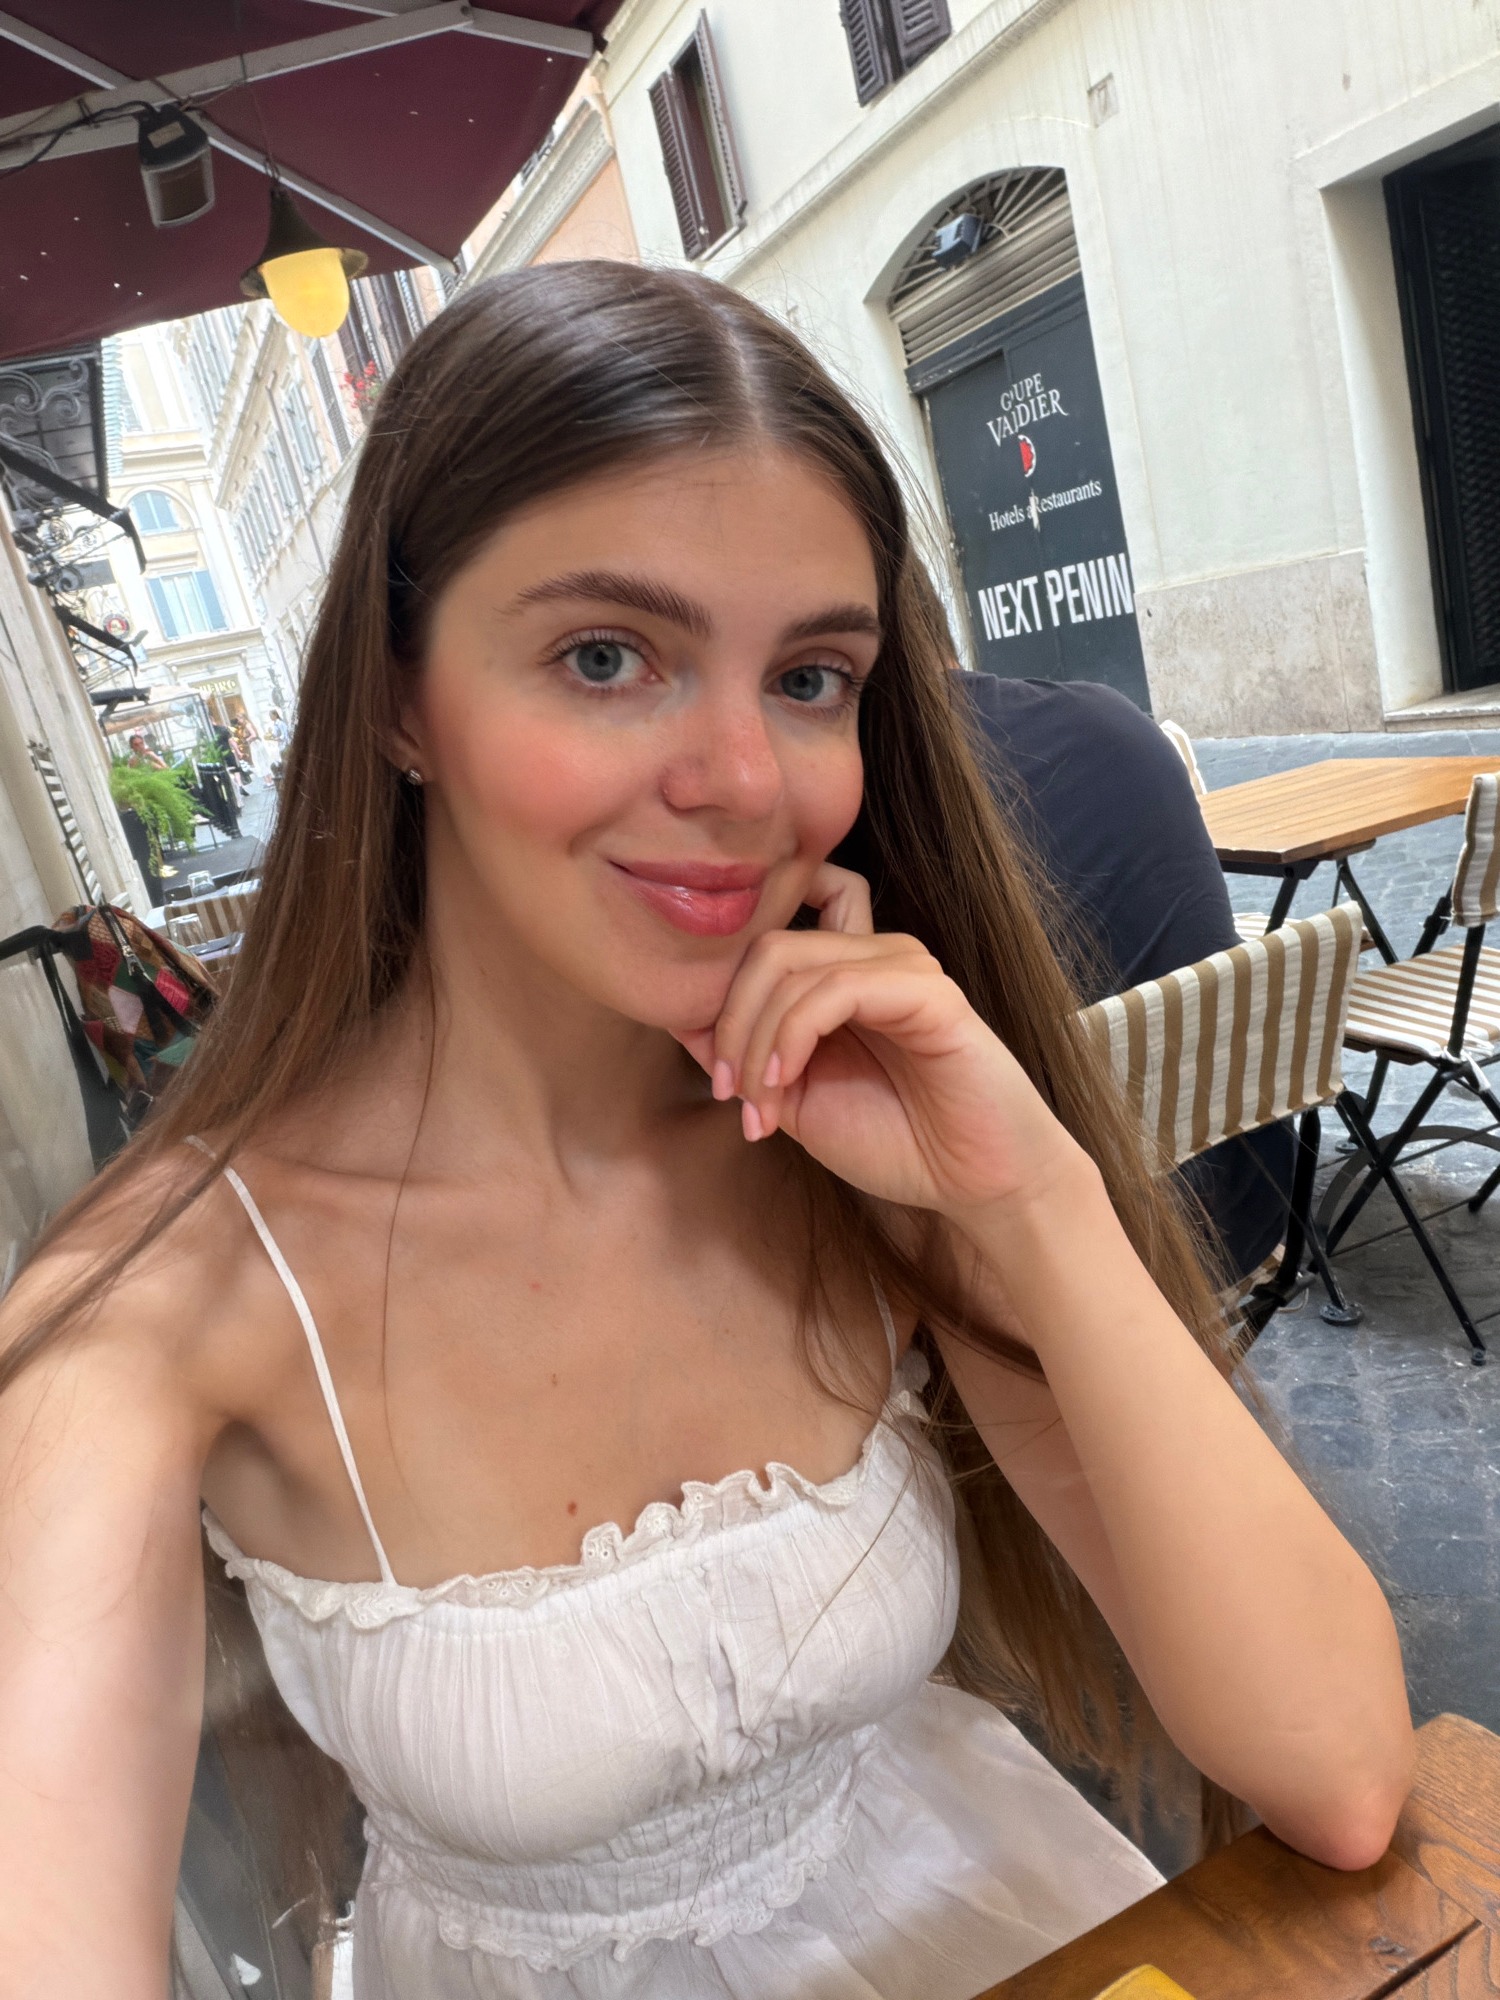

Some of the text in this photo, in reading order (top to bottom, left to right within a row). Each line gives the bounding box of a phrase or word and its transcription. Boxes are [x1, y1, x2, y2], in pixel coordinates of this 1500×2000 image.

[988, 504, 1026, 532] Hotels
[977, 552, 1134, 641] NEXT PENIN
